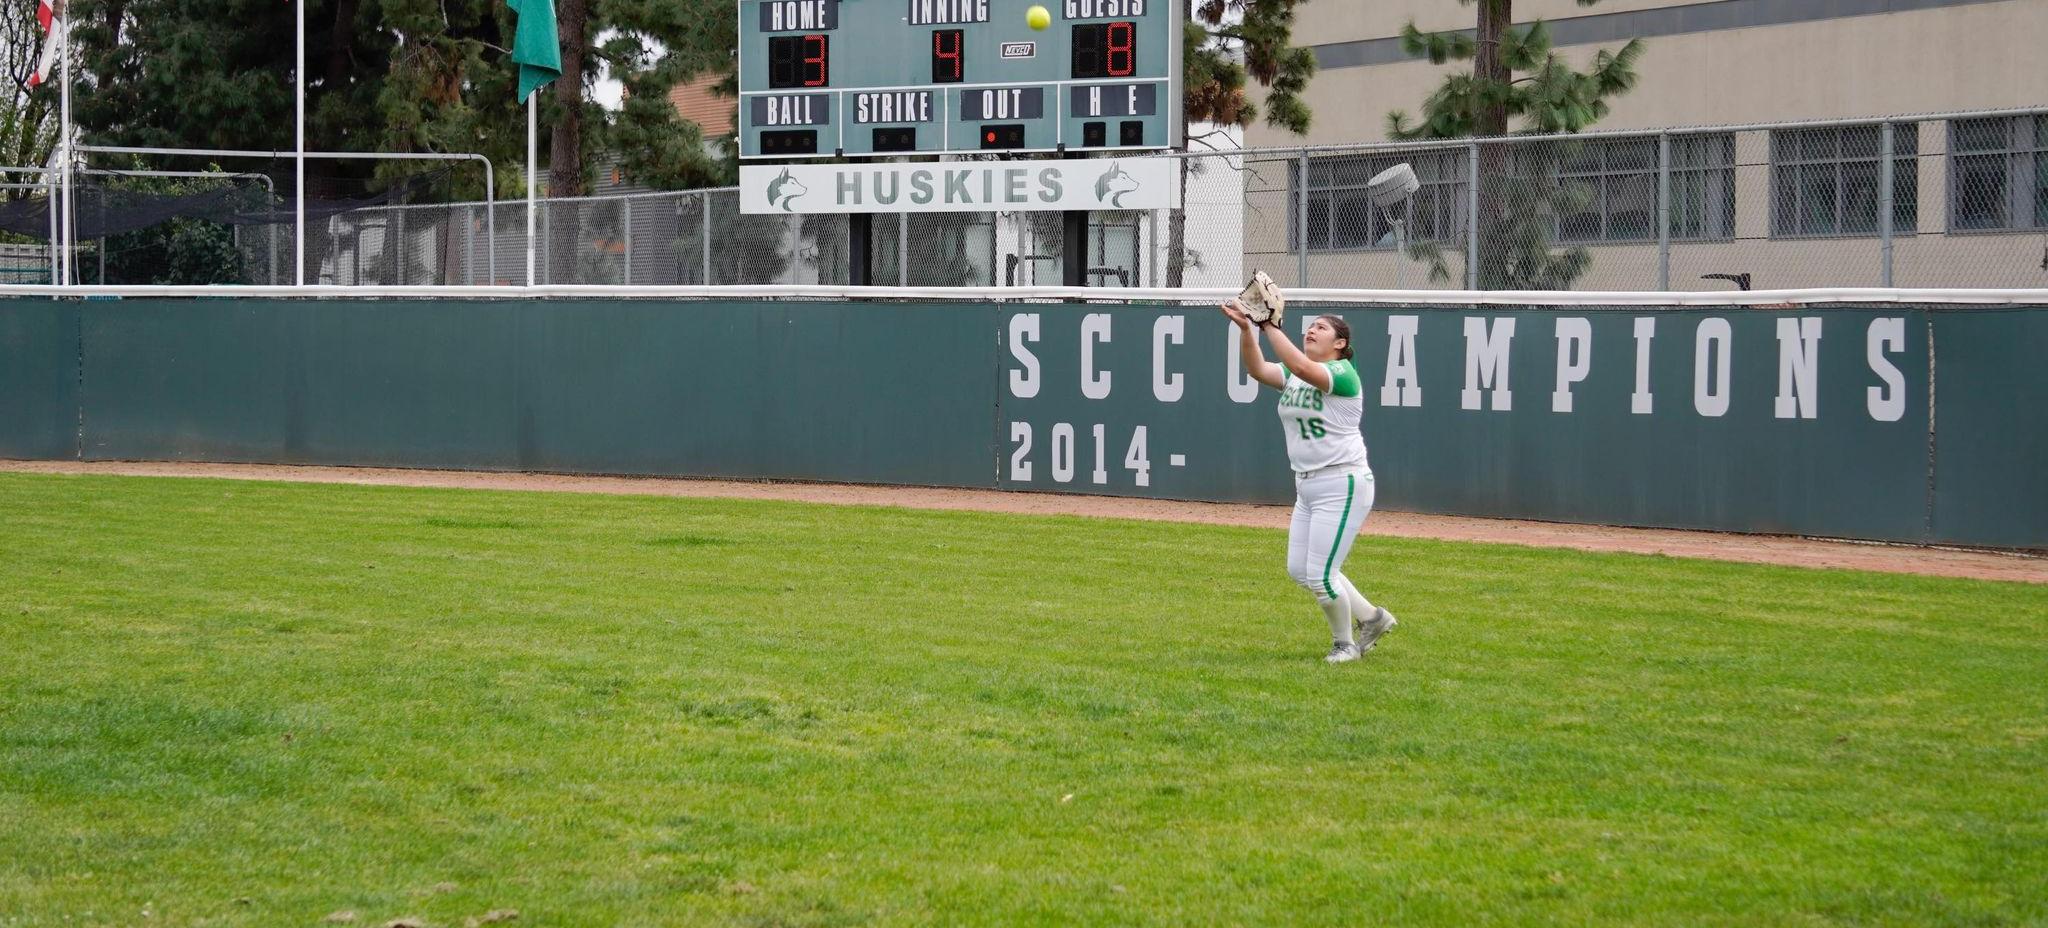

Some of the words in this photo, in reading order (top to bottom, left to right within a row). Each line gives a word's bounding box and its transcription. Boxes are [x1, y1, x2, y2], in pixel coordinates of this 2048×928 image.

[772, 0, 826, 30] HOME
[912, 0, 987, 24] INNING
[1065, 0, 1143, 18] GUESTS
[804, 34, 825, 86] 3
[935, 31, 960, 78] 4
[1107, 22, 1132, 75] 8
[767, 96, 813, 125] BALL
[858, 92, 928, 122] STRIKE
[982, 89, 1022, 119] OUT
[1089, 86, 1101, 116] H
[1128, 85, 1137, 114] E
[836, 167, 1063, 205] HUSKIES
[1227, 314, 1906, 422] CAMPIONS
[1296, 417, 1327, 440] 16
